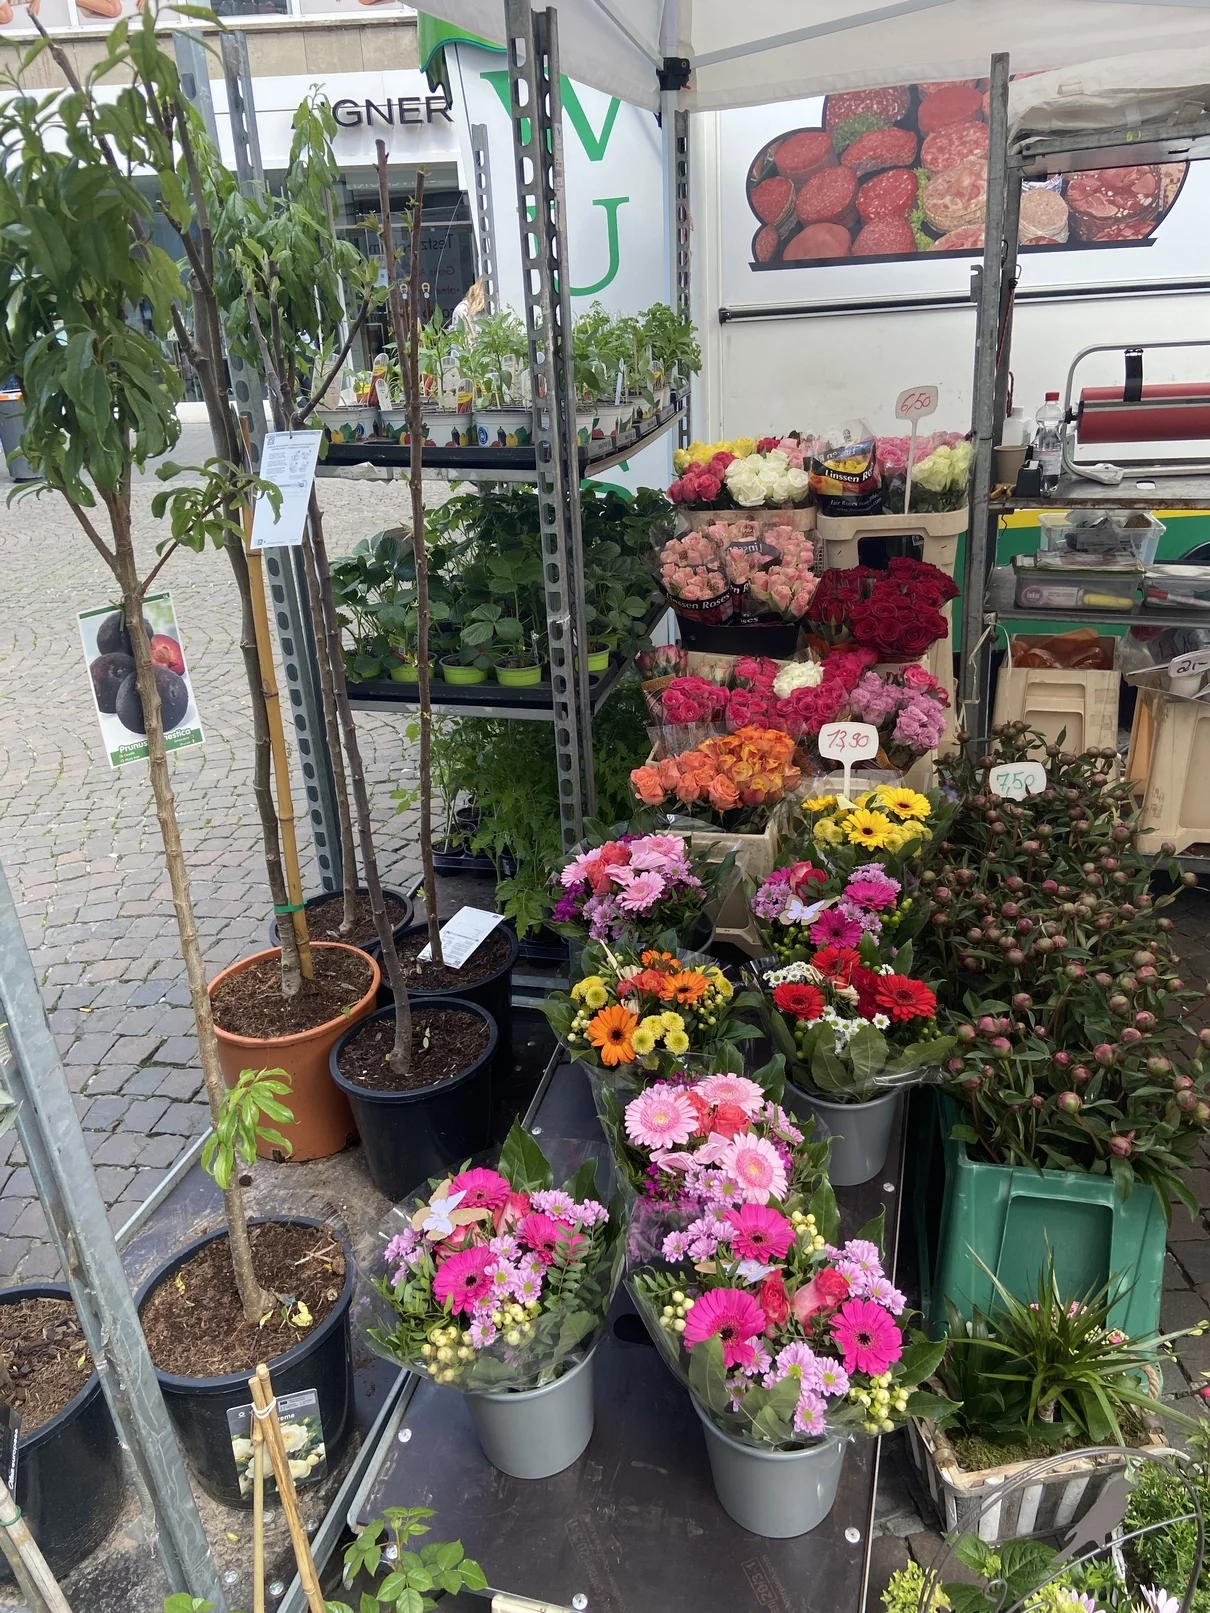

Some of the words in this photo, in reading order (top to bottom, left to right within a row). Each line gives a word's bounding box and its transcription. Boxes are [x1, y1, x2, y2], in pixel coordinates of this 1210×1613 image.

[291, 95, 454, 129] GNER
[900, 392, 931, 416] 6,50
[825, 469, 859, 483] Linssen
[666, 592, 699, 609] Linssen
[702, 592, 730, 609] Roses
[119, 740, 148, 753] Prunus
[827, 729, 869, 753] 13,90
[996, 771, 1035, 796] 7,50
[277, 1412, 295, 1421] reme
[745, 1561, 773, 1601] 20/3-1
